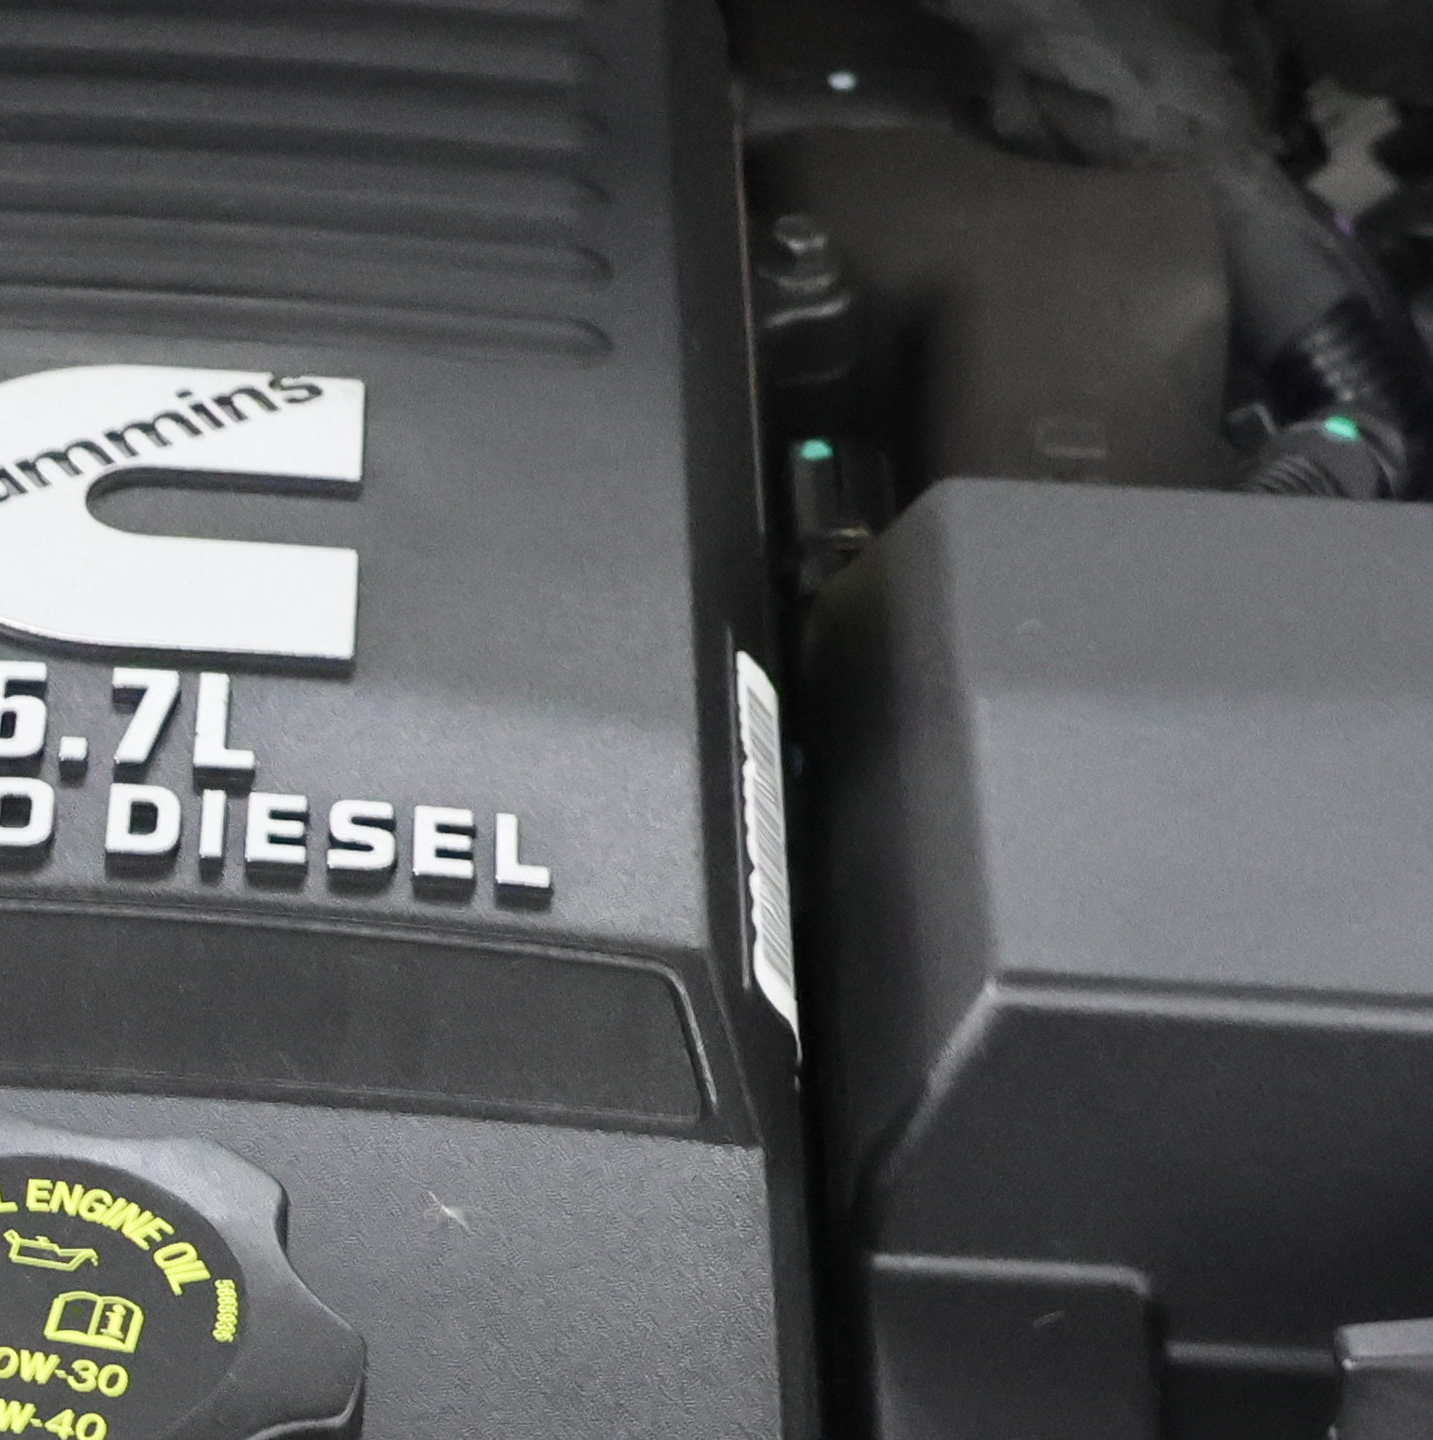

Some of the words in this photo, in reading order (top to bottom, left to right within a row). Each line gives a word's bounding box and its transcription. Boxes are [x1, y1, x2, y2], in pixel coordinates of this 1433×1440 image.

[102, 782, 553, 890] DIESEL
[25, 1178, 176, 1251] ENGINE
[153, 1242, 212, 1296] OIL
